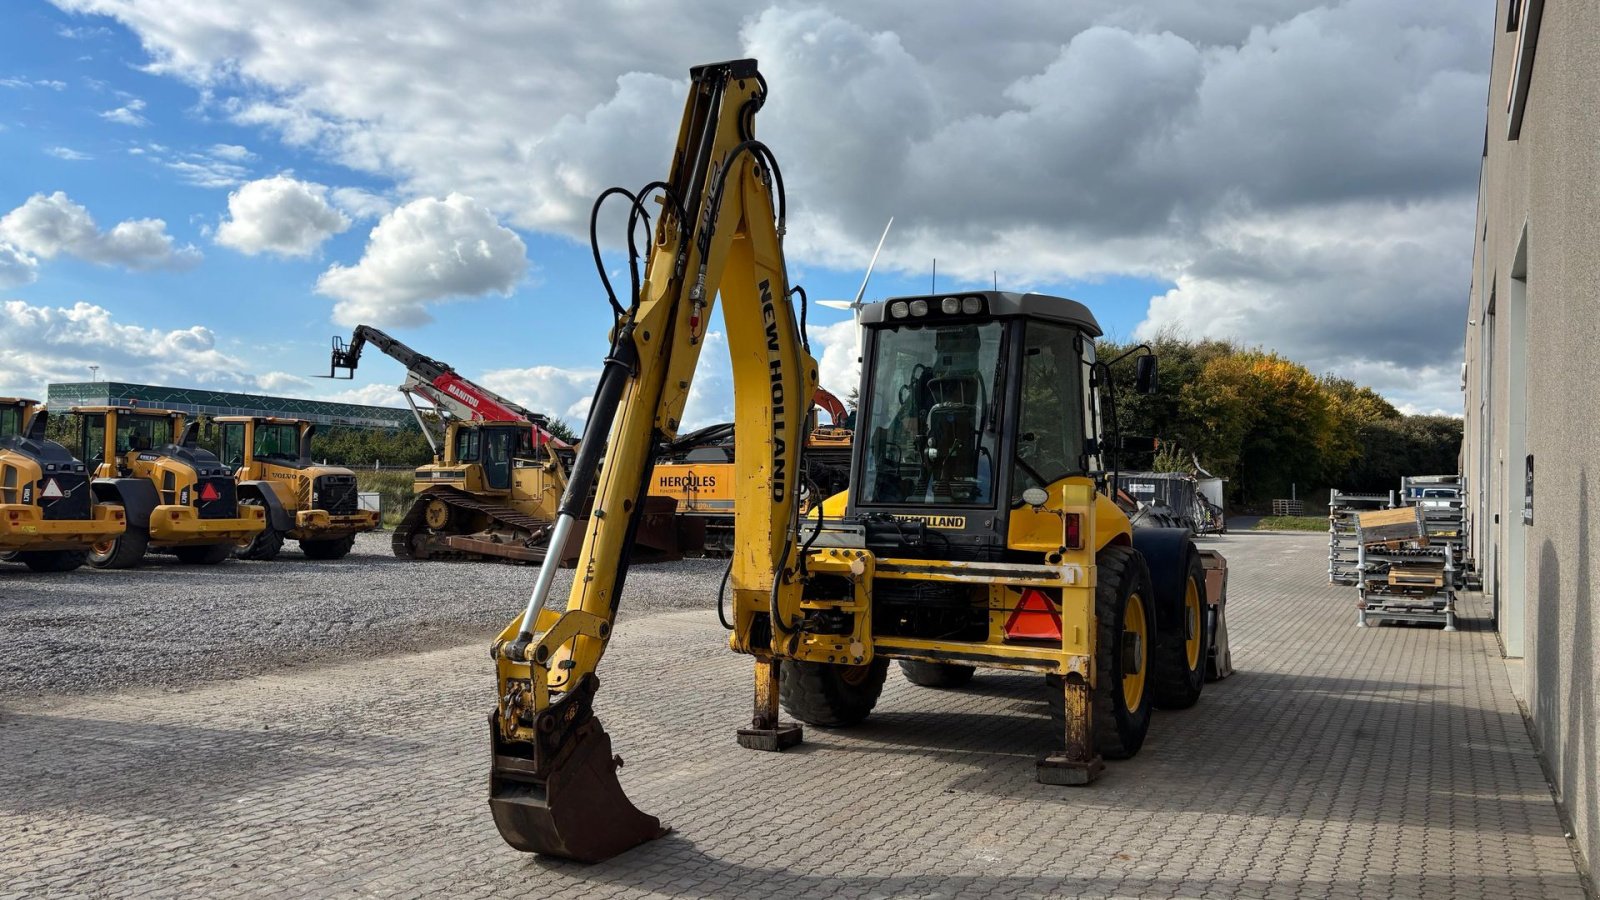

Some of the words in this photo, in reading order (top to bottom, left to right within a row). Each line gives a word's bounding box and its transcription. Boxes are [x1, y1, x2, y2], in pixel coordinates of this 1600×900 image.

[447, 383, 479, 408] MANITOU
[758, 278, 780, 351] NEW
[769, 359, 786, 503] HOLLAND
[271, 472, 297, 480] VOLVO
[660, 476, 716, 487] HERCULES
[23, 488, 31, 502] L70H
